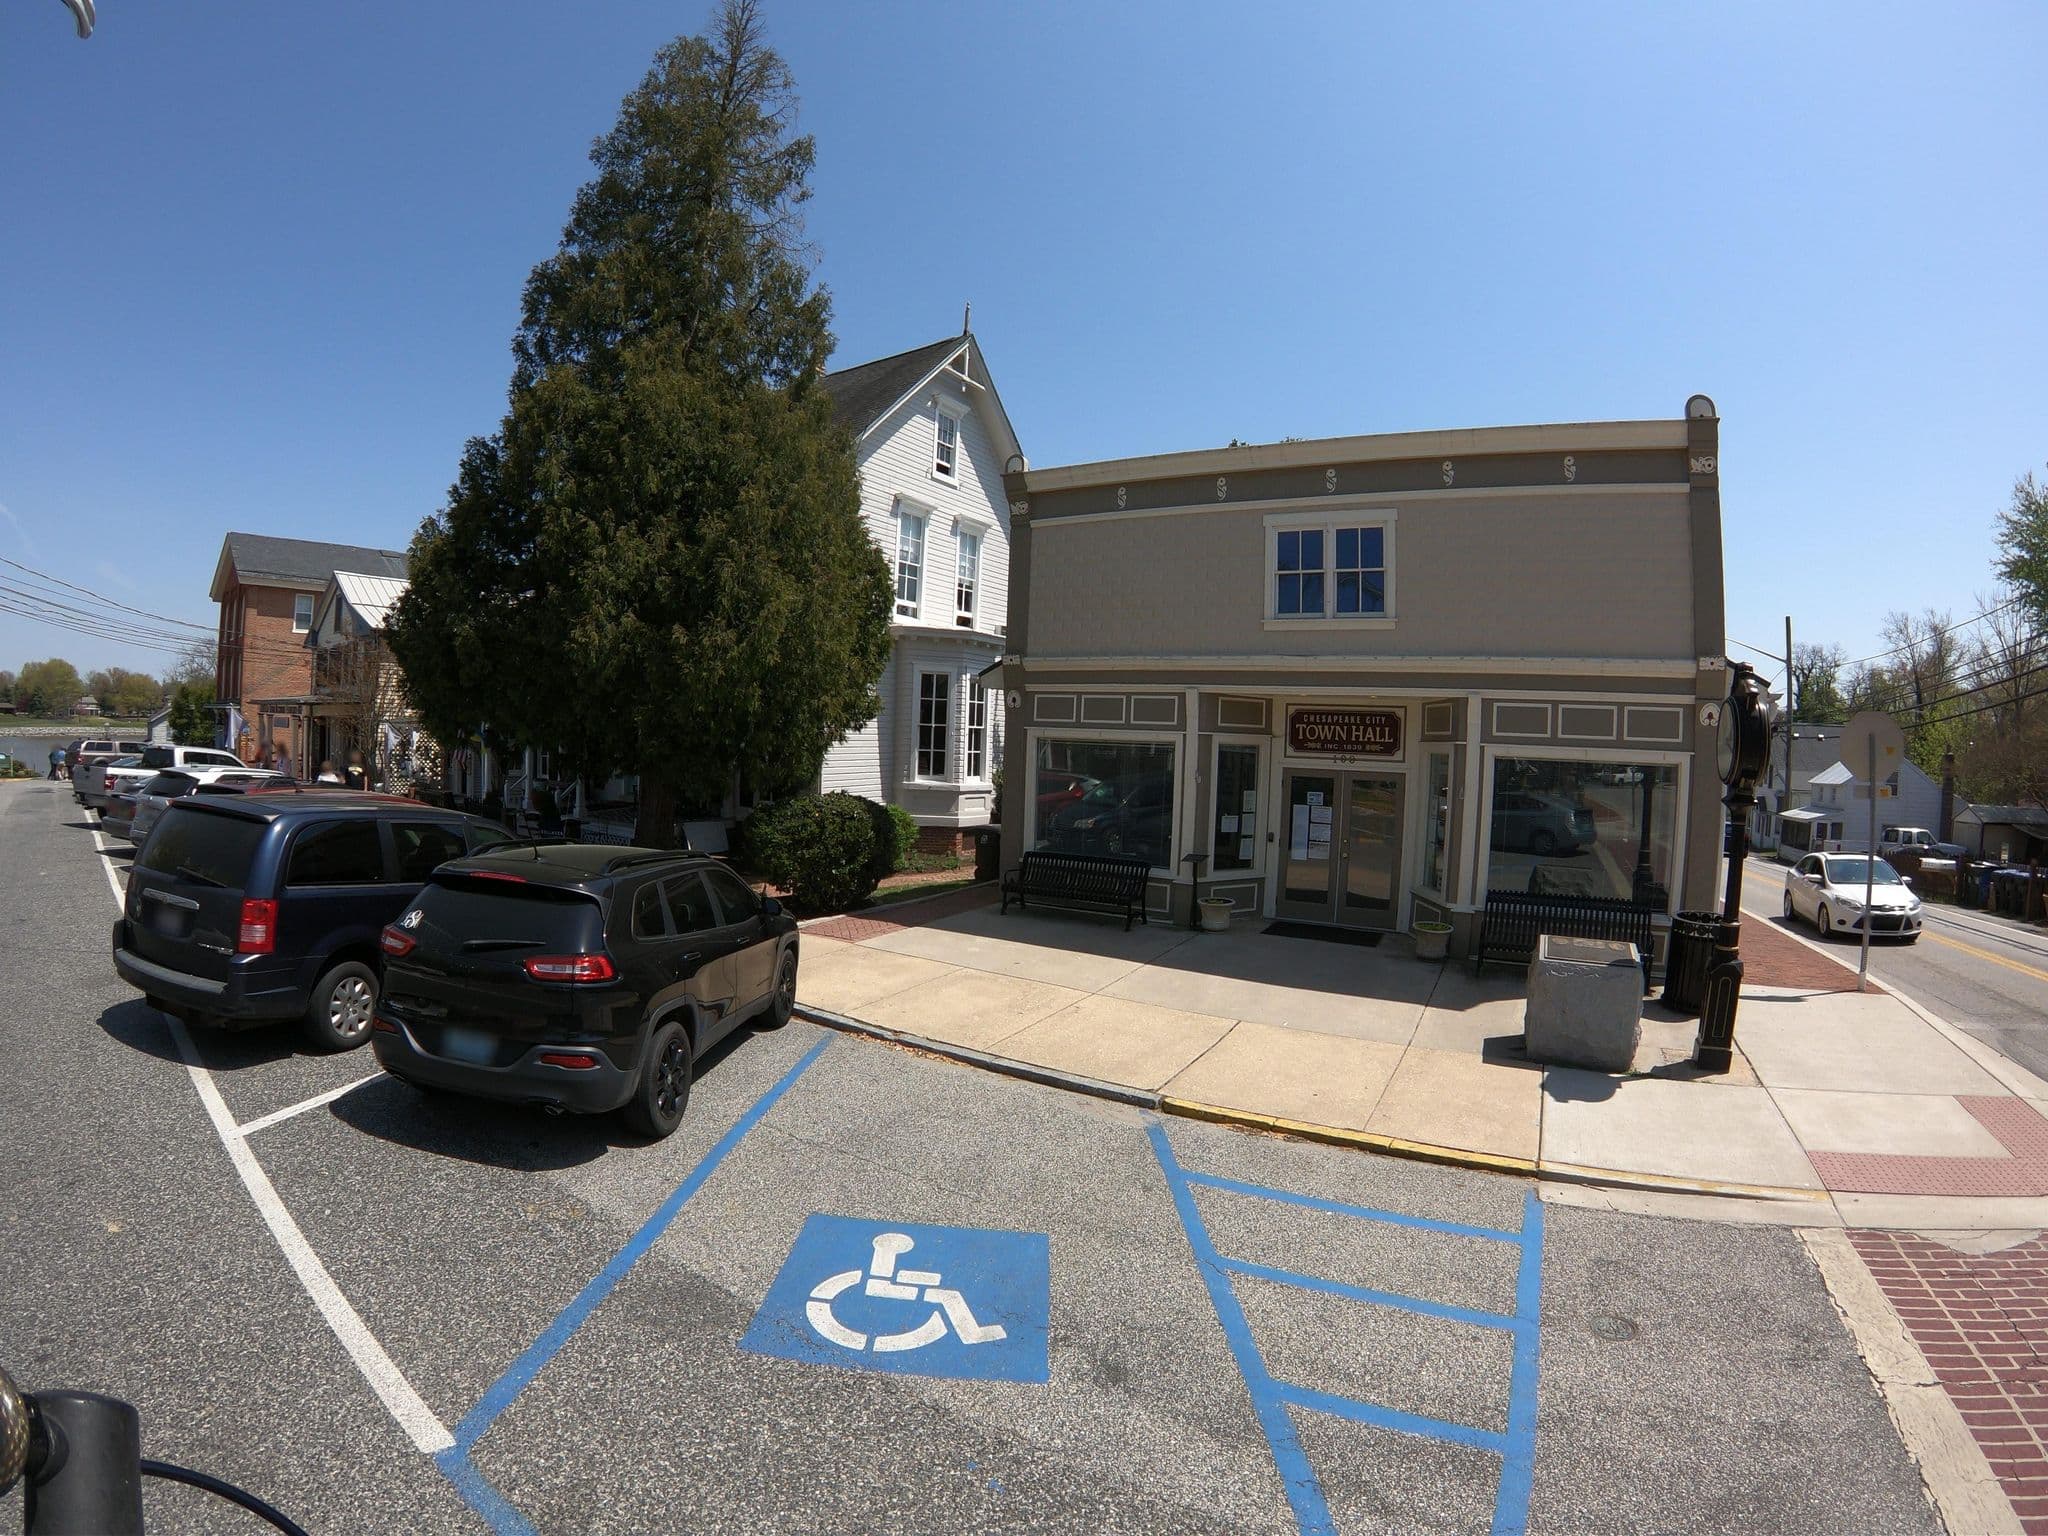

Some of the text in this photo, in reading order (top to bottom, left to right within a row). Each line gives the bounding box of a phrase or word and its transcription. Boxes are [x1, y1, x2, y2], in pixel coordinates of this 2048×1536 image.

[1303, 714, 1387, 725] CHESAPEAKE CITY
[1295, 724, 1394, 742] TOWN HALL
